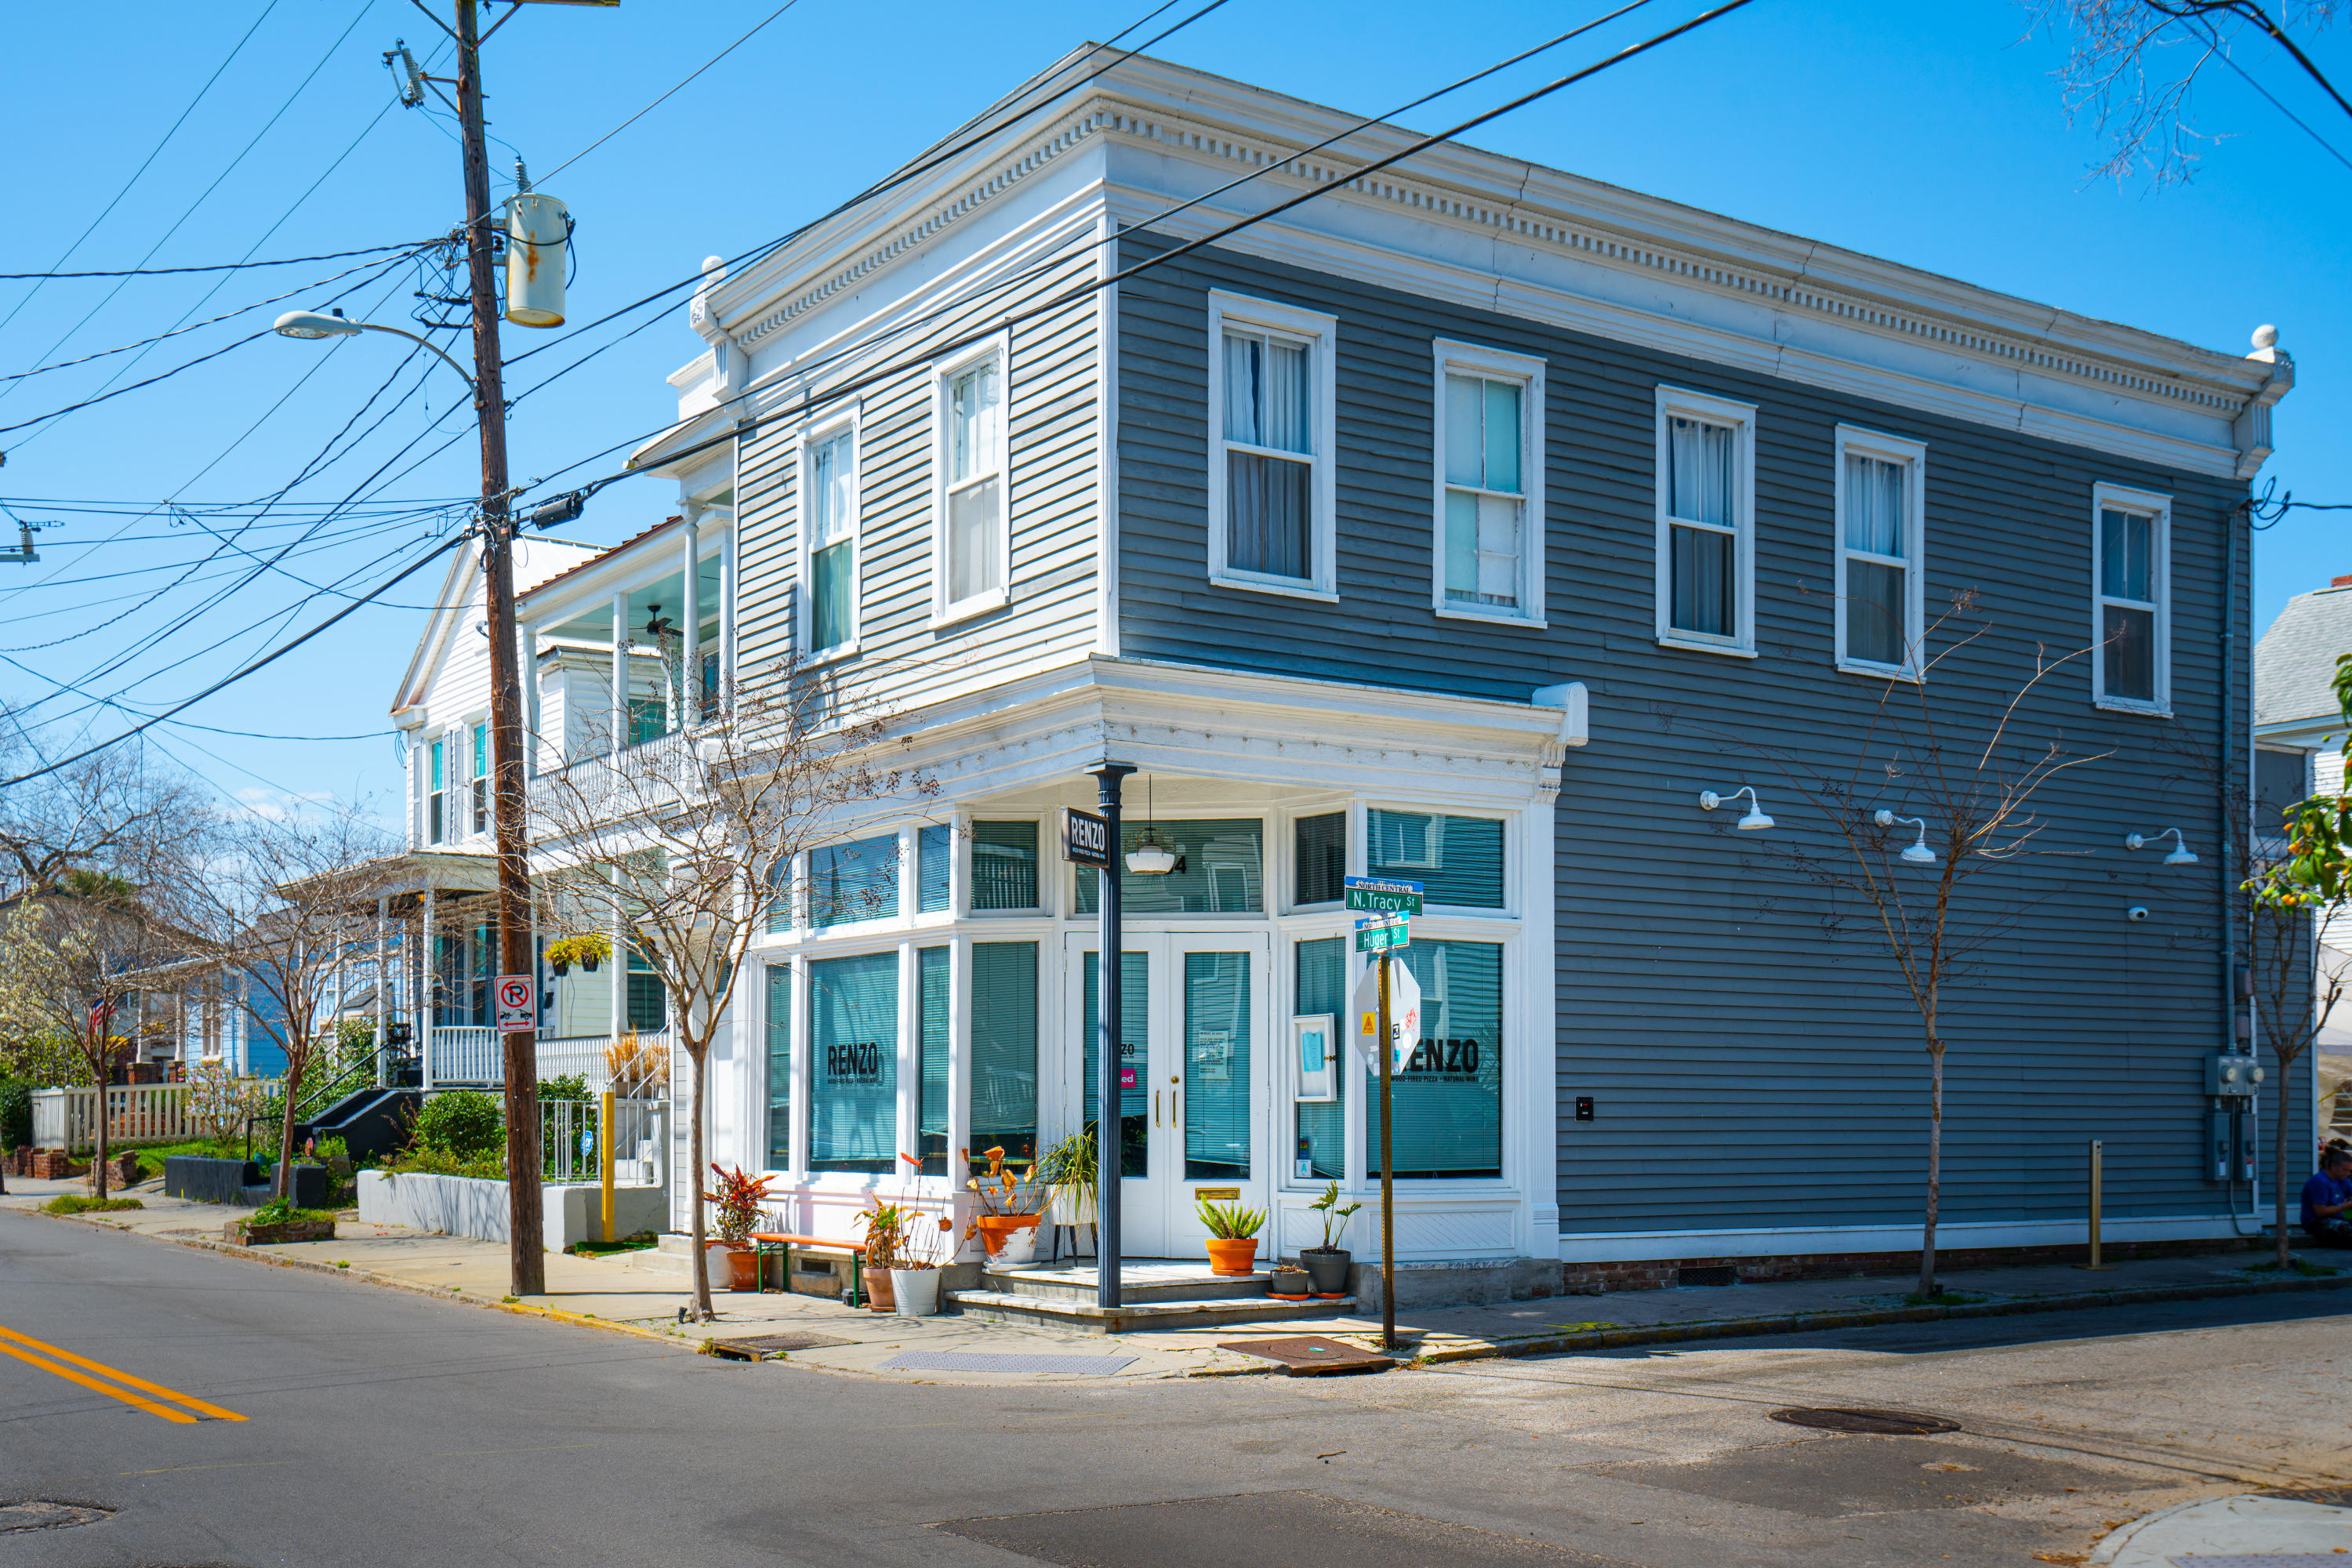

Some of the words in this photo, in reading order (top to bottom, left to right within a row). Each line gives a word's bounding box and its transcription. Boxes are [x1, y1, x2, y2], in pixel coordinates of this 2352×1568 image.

[1071, 815, 1105, 851] RENZO
[1381, 884, 1410, 893] CENTRAL
[1406, 896, 1415, 907] St
[1364, 932, 1388, 948] Huger
[1393, 927, 1400, 939] St
[828, 1042, 878, 1076] RENZO
[1403, 1038, 1479, 1073] ENZO
